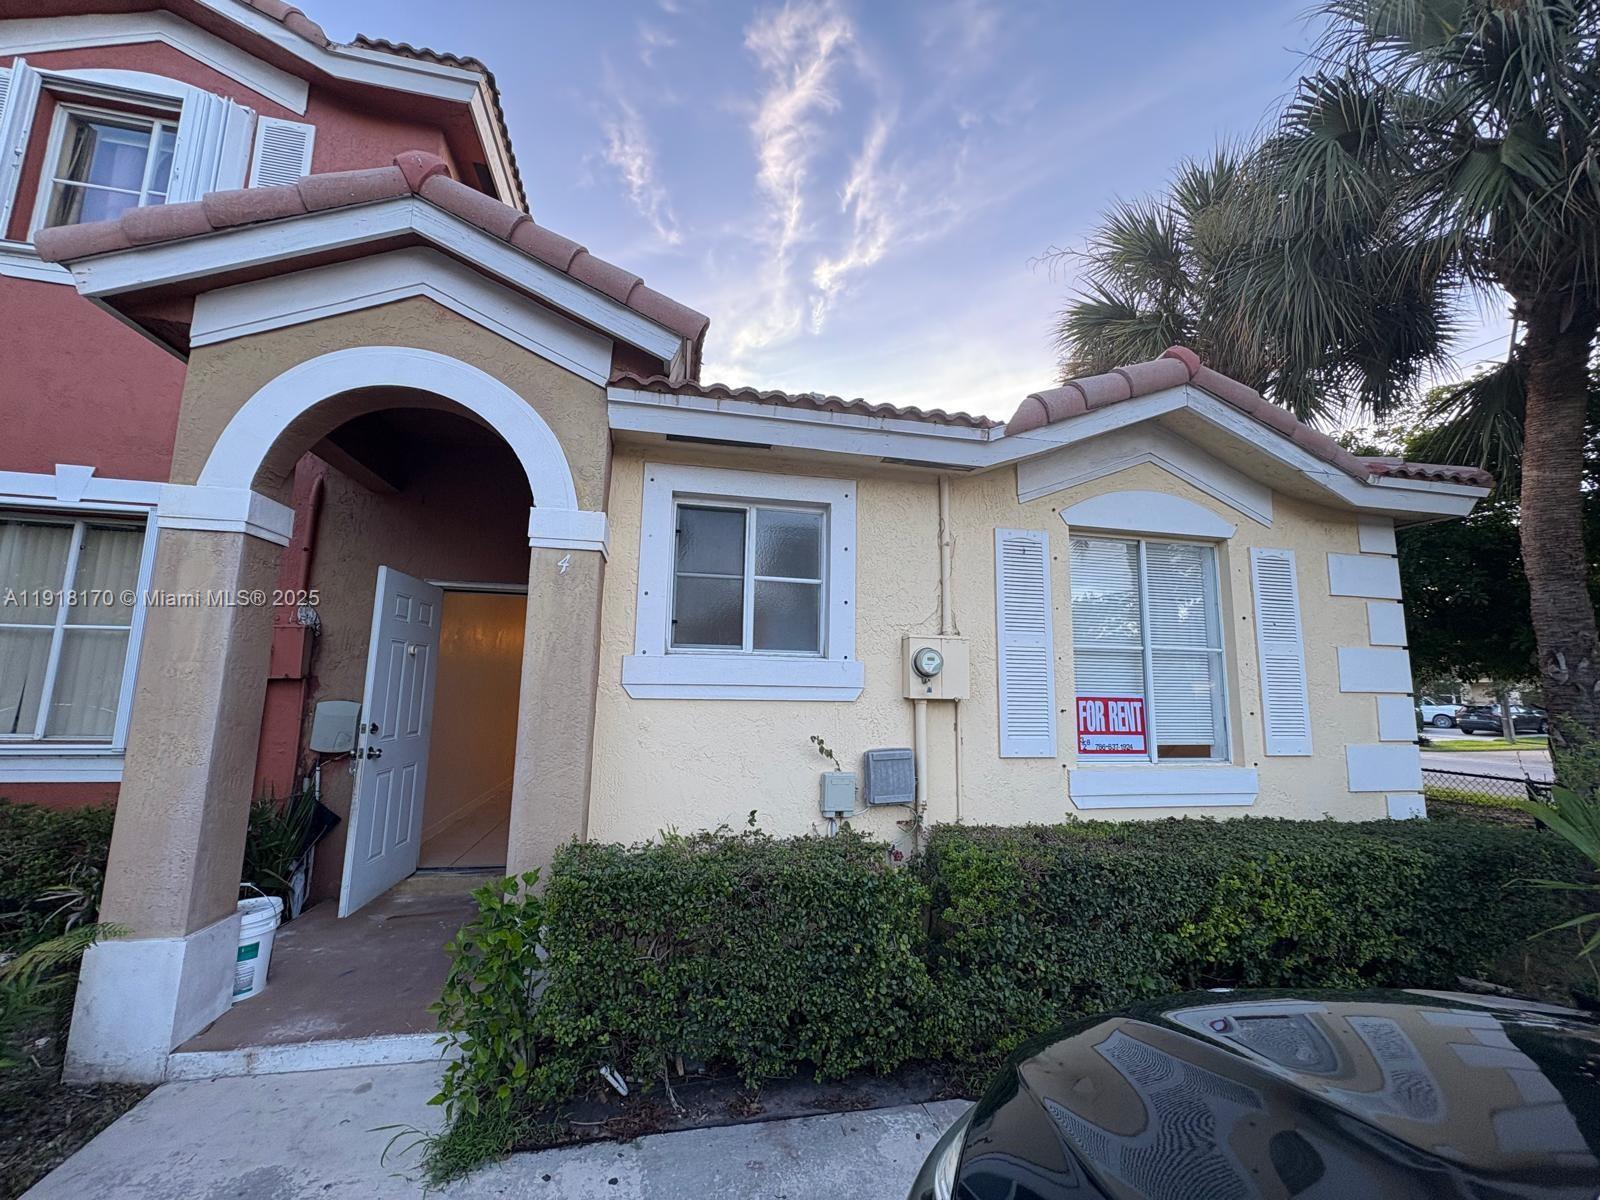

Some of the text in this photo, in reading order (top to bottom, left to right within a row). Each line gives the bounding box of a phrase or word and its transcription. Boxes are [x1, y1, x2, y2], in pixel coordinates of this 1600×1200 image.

[557, 554, 571, 574] 4
[1078, 700, 1142, 732] FOR RENT
